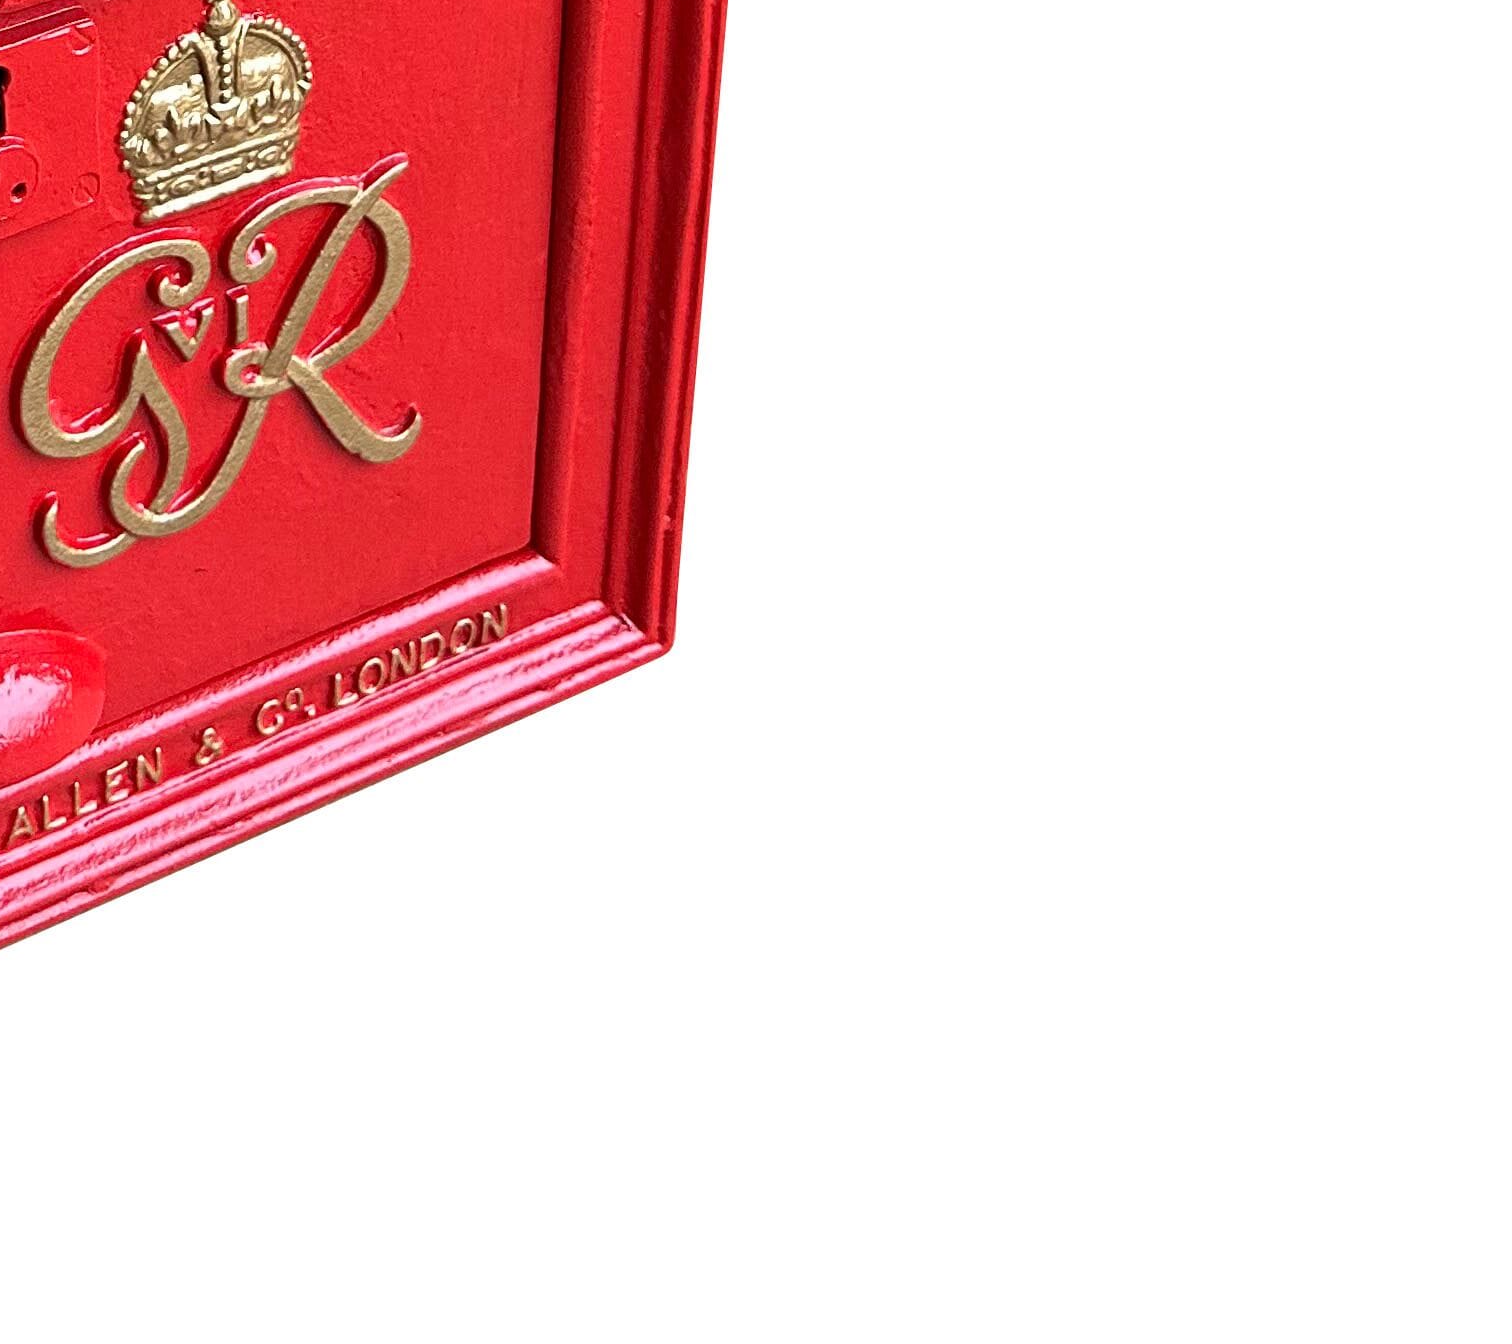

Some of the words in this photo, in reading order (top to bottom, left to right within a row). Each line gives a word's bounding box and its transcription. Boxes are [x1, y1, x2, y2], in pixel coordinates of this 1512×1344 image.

[7, 746, 164, 848] ALLEN
[193, 726, 224, 768] &
[331, 602, 509, 707] LONDON
